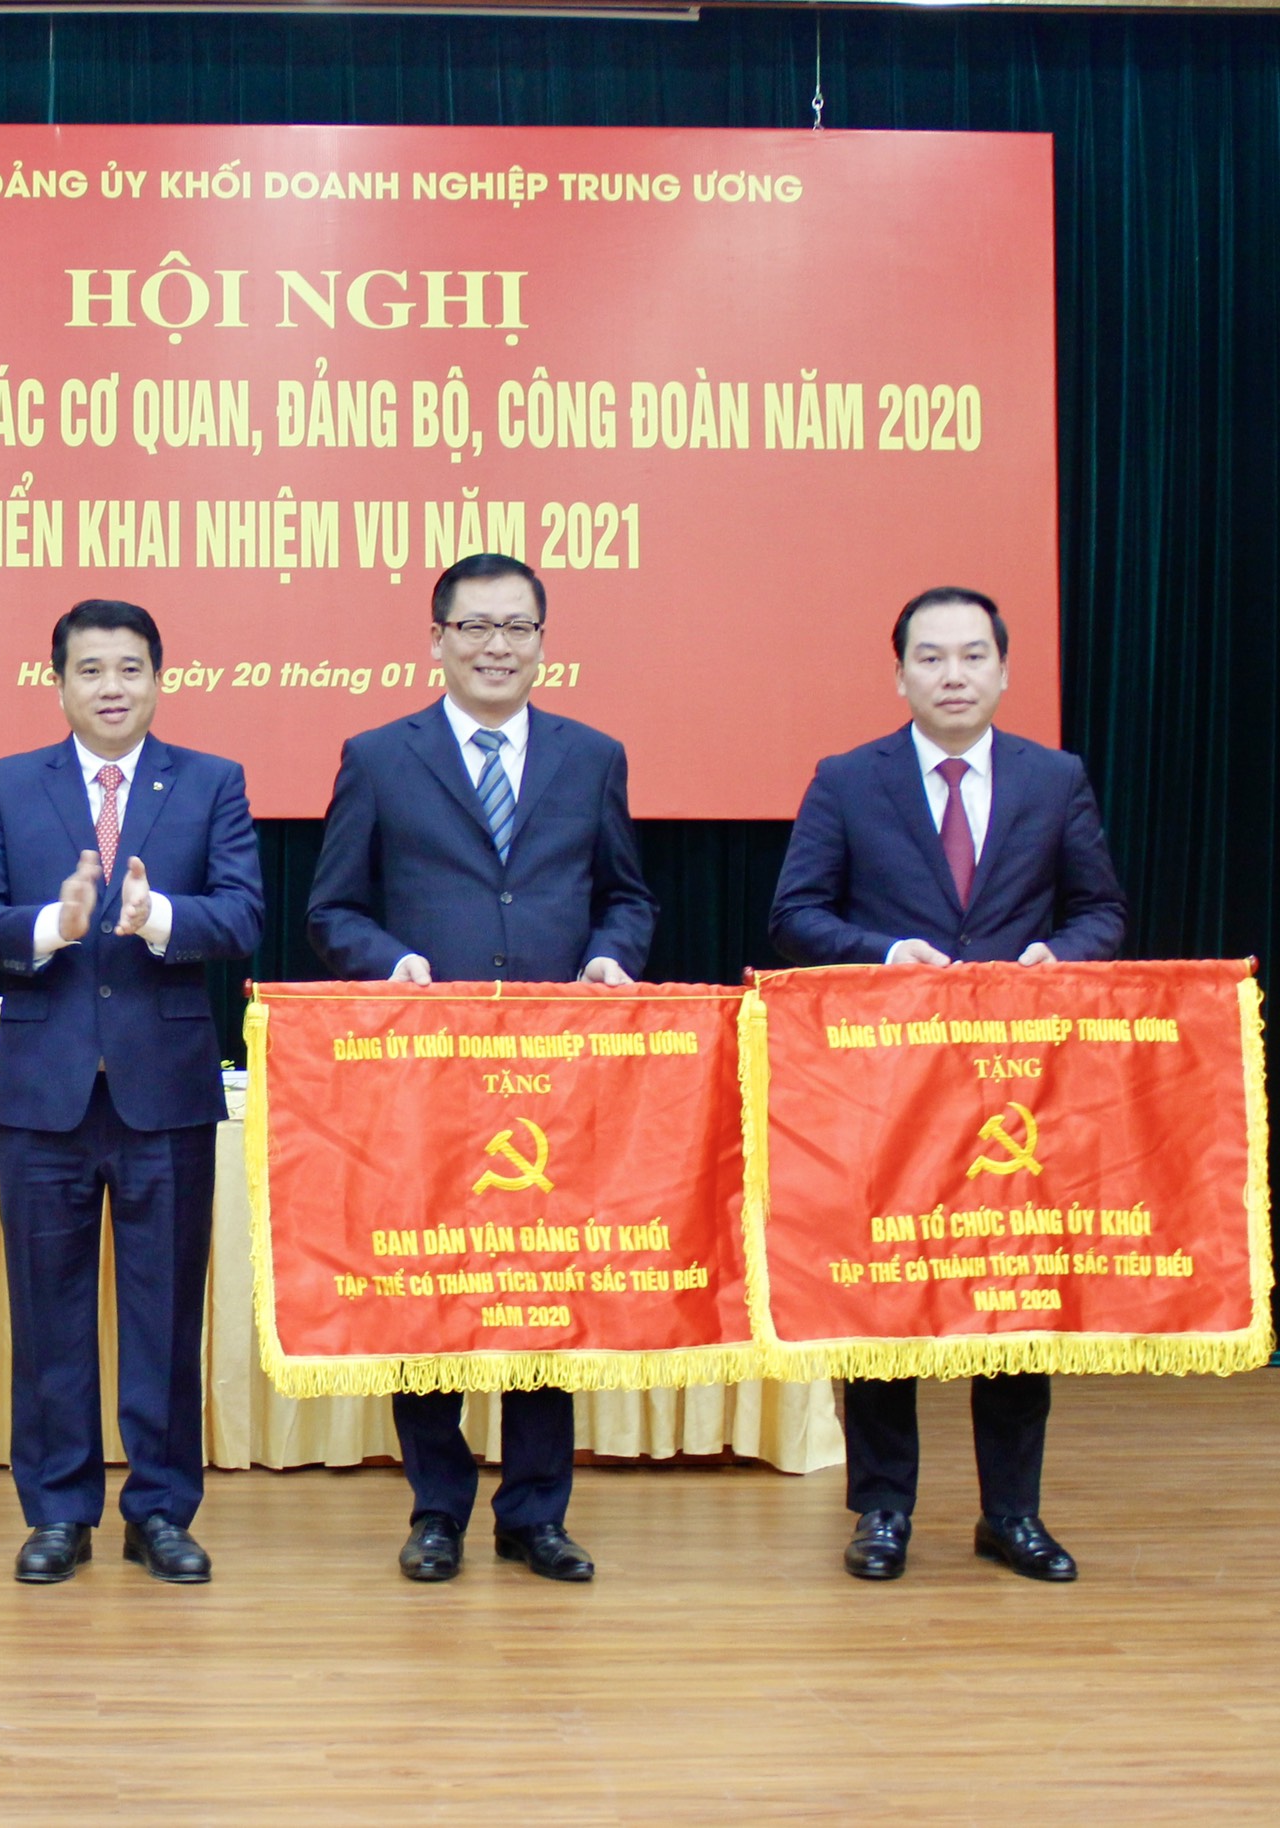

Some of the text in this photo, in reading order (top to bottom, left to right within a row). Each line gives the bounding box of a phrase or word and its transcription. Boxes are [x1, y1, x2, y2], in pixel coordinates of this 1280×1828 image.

[101, 161, 147, 199] ỦY
[161, 160, 251, 200] KHỐI
[265, 172, 399, 201] DOANH
[413, 165, 548, 208] NGHIỆP
[558, 173, 681, 203] TRUNG
[693, 171, 803, 203] ƯƠNG
[64, 250, 529, 346] HỘI NGHỊ
[60, 372, 120, 448] CƠ
[133, 379, 263, 456] QUAN,
[277, 357, 397, 449] ĐẢNG
[412, 366, 483, 464] BỘ,
[498, 367, 618, 450] CÔNG
[629, 368, 750, 451] ĐOÀN
[763, 368, 865, 452] NĂM
[878, 383, 982, 453] 2020
[79, 500, 181, 568] KHAI
[196, 486, 340, 585] NHIỆM
[353, 501, 409, 585] VỤ
[424, 487, 526, 569] NĂM
[540, 501, 641, 570] 2021
[161, 660, 224, 694] gày
[231, 662, 272, 688] 20
[280, 660, 373, 695] tháng
[381, 662, 417, 688] 01
[334, 1028, 699, 1061] ĐẢNG ỦY KHỐI DOANH NGHIỆP TRUNG ƯƠNG
[827, 1013, 1179, 1049] ĐẢNG ỦY KHỐI DOANH NGHIỆP TRUNG ƯƠNG
[483, 1069, 552, 1098] TẶNG
[974, 1054, 1043, 1083] TẶNG
[372, 1216, 670, 1258] BAN DÂN VẬN ĐẢNG ỦY KHỐI
[871, 1201, 1151, 1243] BAN TỔ CHỨC ĐẢNG ỦY KHỐI
[334, 1261, 709, 1301] TẬP THỂ CÓ THÀNH TÍCH XUẤT SẮC TIÊU BIỂU
[829, 1246, 1193, 1287] TẬP THỂ CÓ THÀNH TÍCH XUẤT SẮC TIÊU BIỂU
[481, 1302, 571, 1328] NĂM 2020
[974, 1287, 1062, 1312] NĂM 2020
